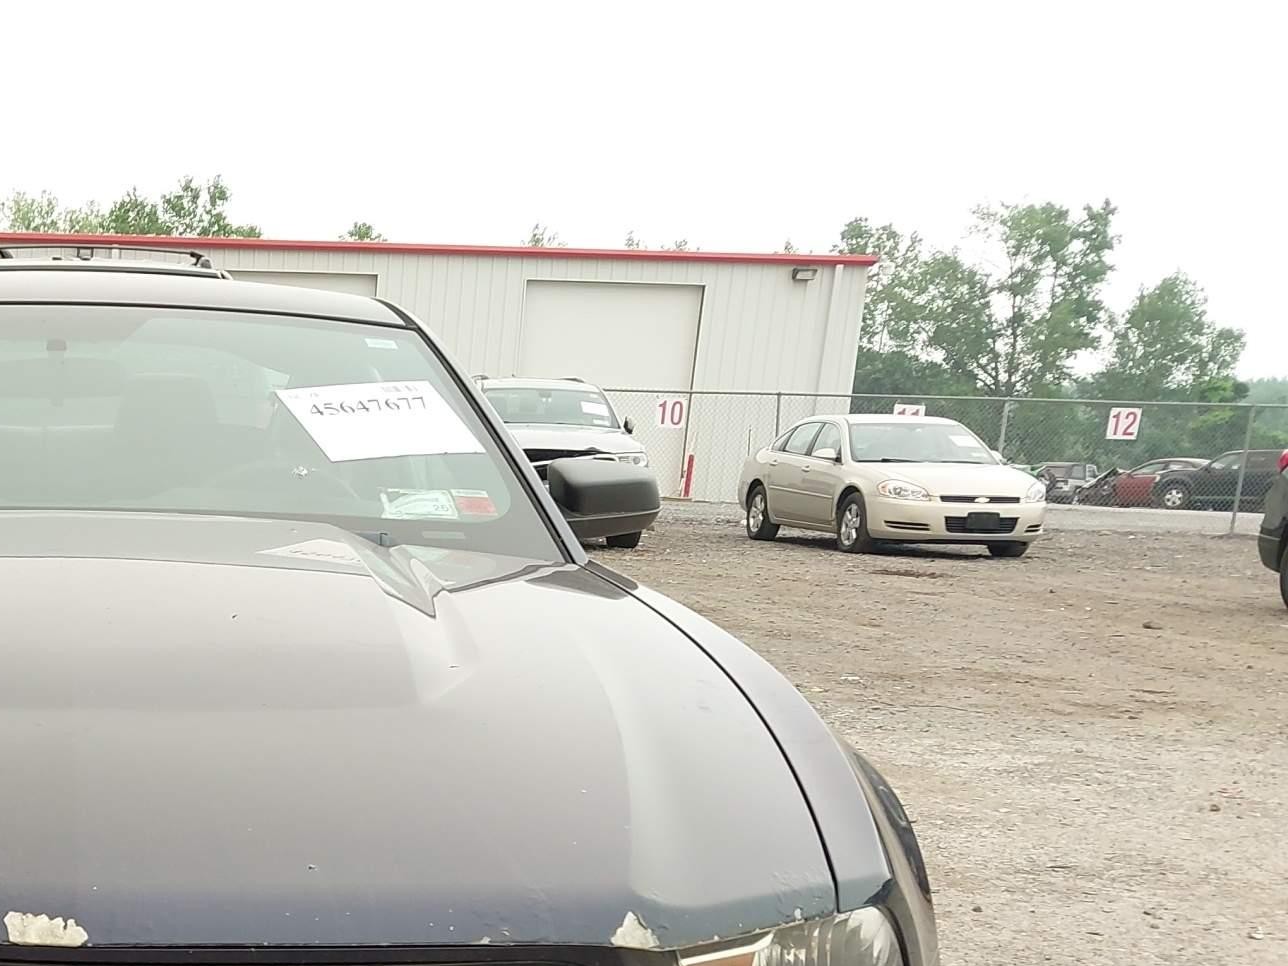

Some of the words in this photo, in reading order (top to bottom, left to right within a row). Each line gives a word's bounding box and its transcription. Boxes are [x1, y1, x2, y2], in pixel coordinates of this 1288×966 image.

[310, 396, 426, 416] 45647677
[658, 400, 684, 425] 10
[1112, 411, 1138, 436] 12
